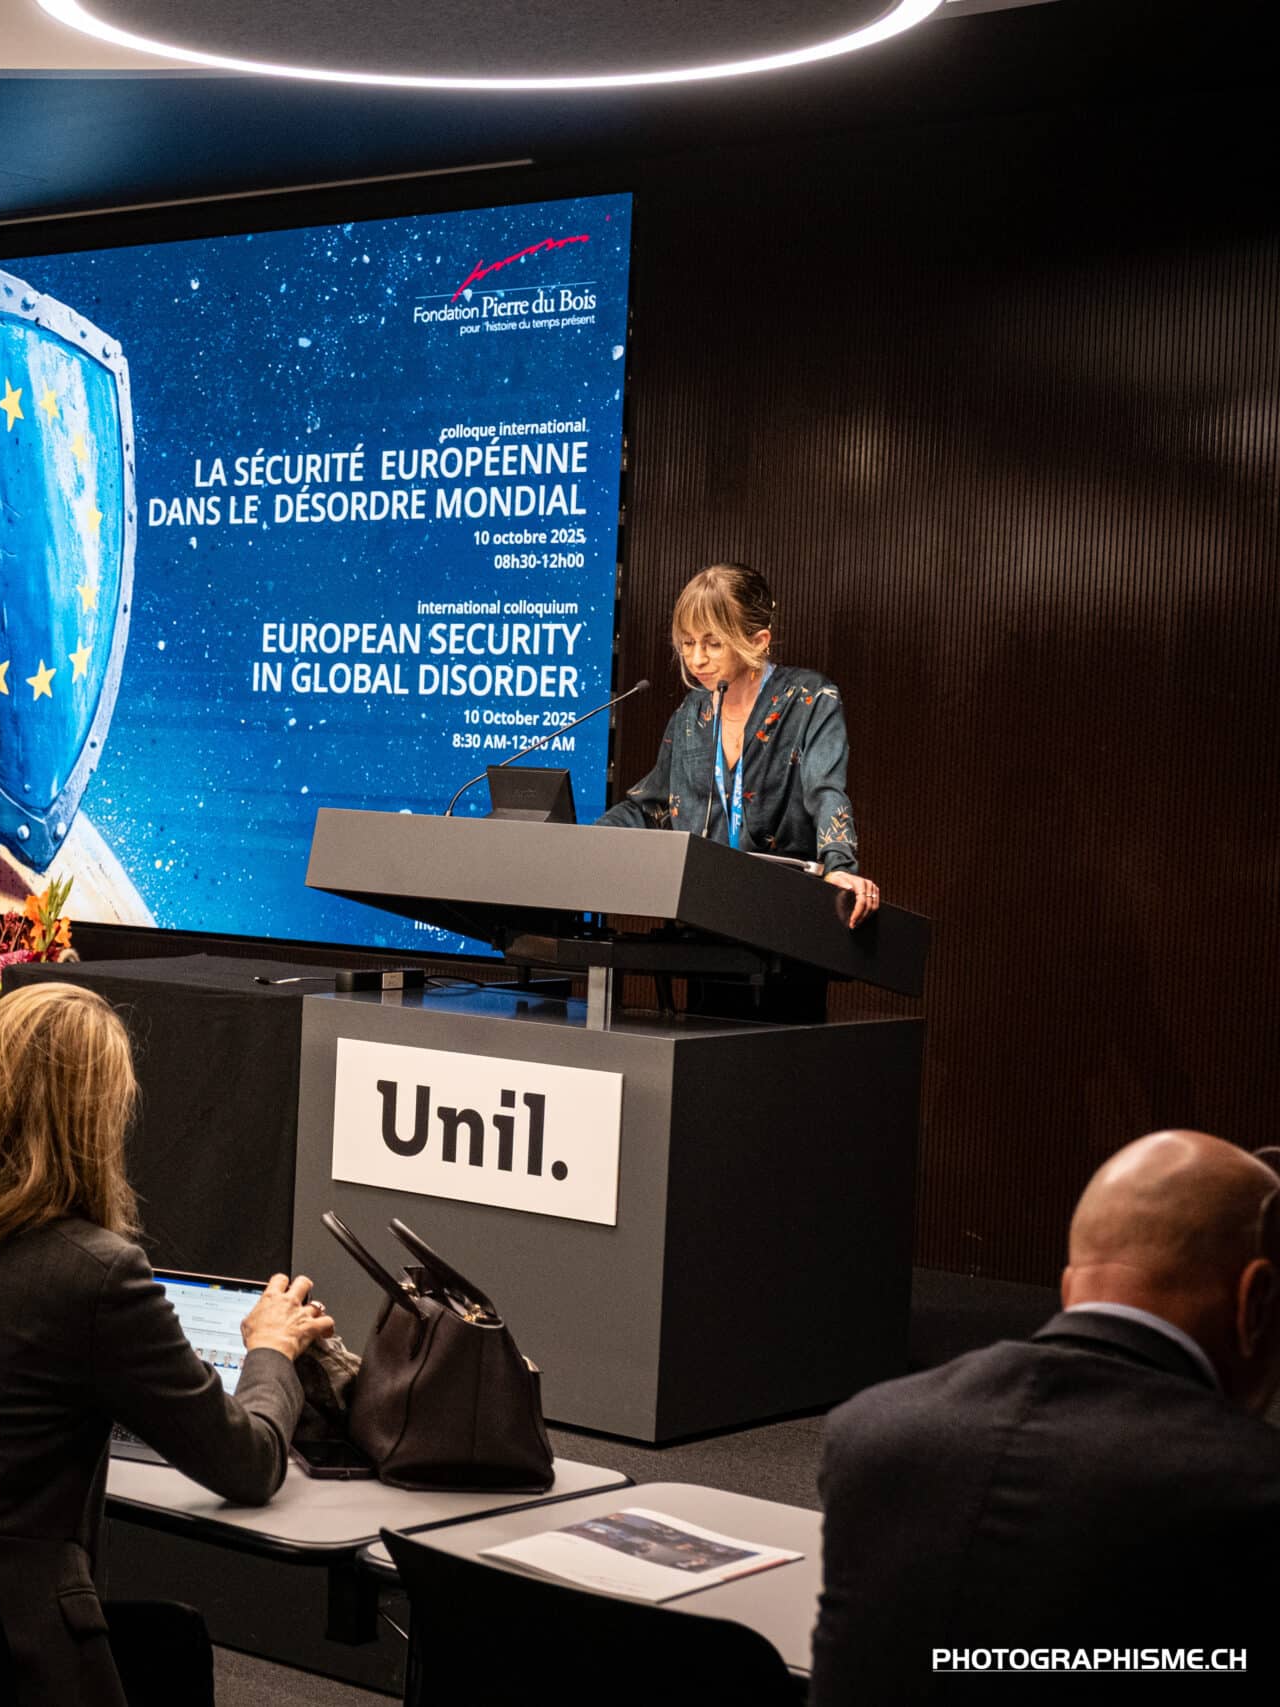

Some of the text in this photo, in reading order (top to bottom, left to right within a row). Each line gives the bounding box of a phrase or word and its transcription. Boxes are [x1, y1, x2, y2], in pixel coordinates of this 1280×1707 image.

[414, 289, 597, 323] Fondation Pierre du Bois
[459, 324, 481, 336] pour
[519, 318, 531, 330] du
[532, 317, 560, 332] temps
[441, 416, 587, 442] colloque international
[194, 438, 588, 488] LA SÉCURITÉ EUROPÉENNE
[148, 483, 587, 527] DANS LE DÉSORDRE MONDIAL
[473, 528, 586, 545] 10 octobre 2025
[494, 553, 585, 569] 08h30-12h00
[417, 599, 579, 619] international colloquium
[262, 622, 583, 656] EUROPEAN SECURITY
[252, 661, 579, 698] IN GLOBAL DISORDER
[463, 709, 577, 727] 10 October 2025
[452, 733, 481, 748] 8:30
[551, 736, 576, 751] AM
[376, 1079, 568, 1181] Unil.
